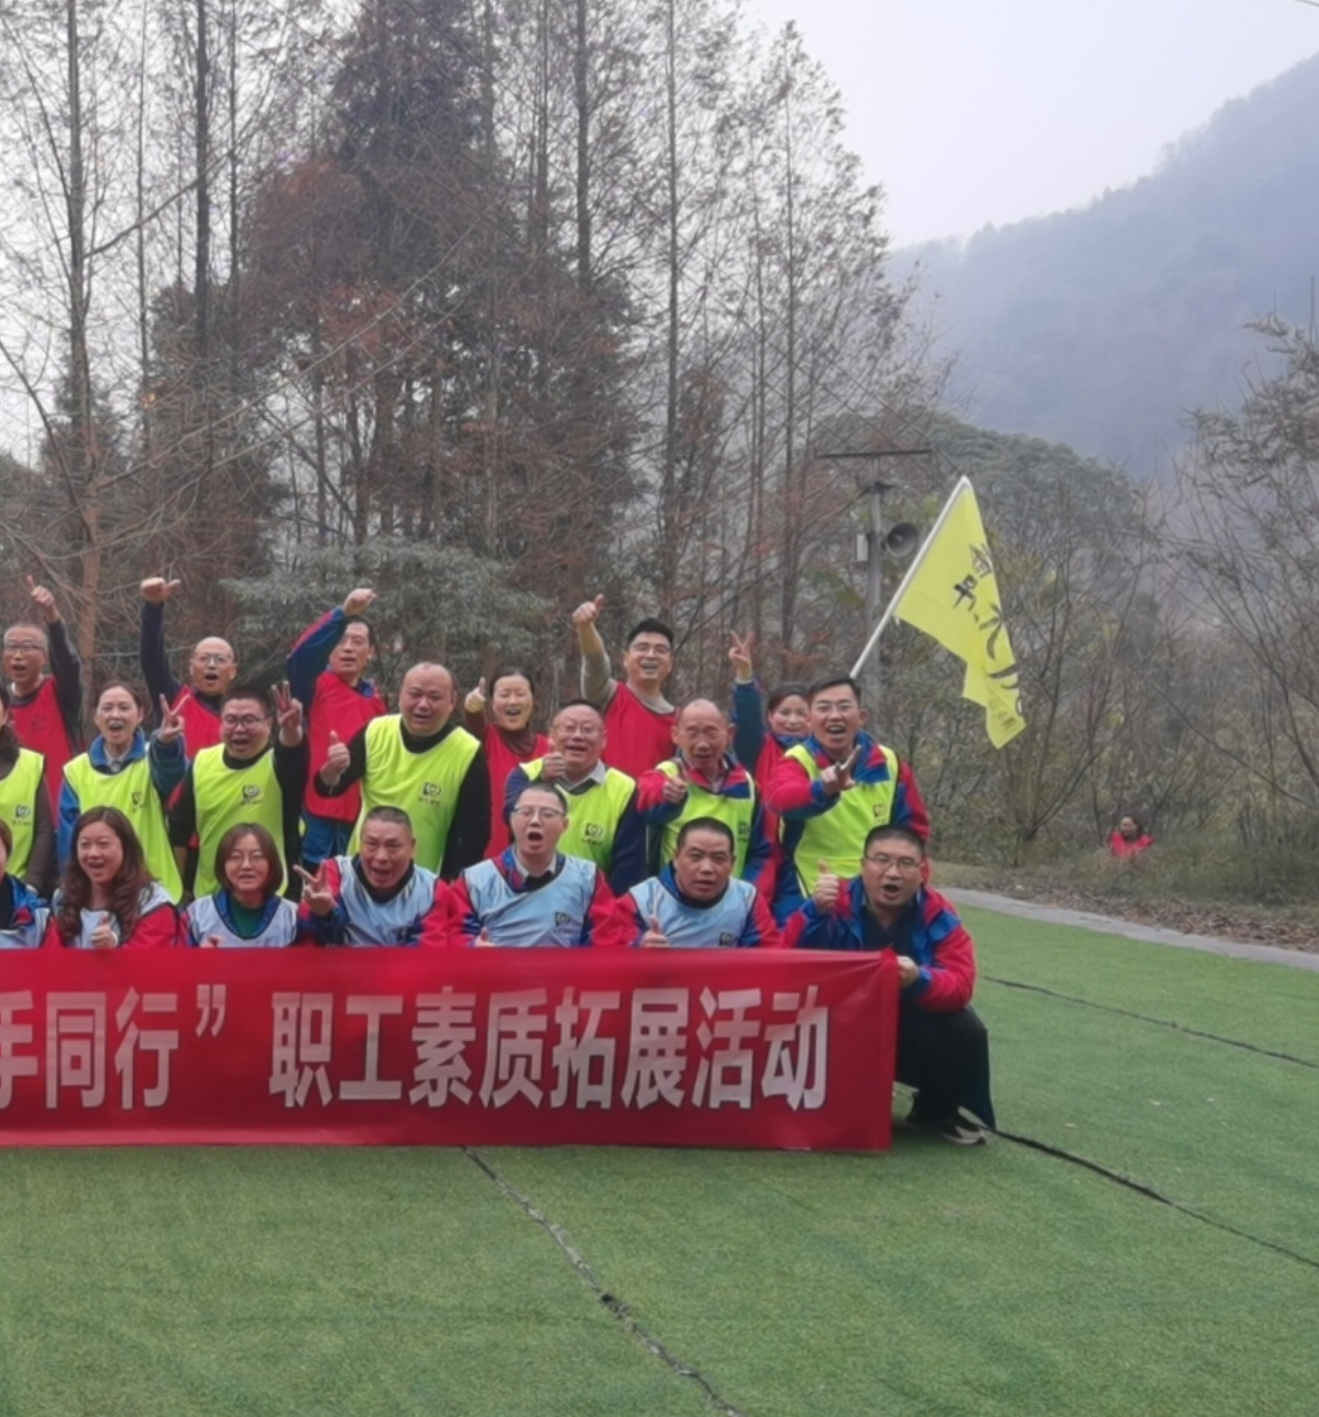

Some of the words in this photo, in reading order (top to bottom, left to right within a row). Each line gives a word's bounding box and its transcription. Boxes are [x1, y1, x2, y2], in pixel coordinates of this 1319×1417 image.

[268, 985, 831, 1112] 职工素质拓展活动
